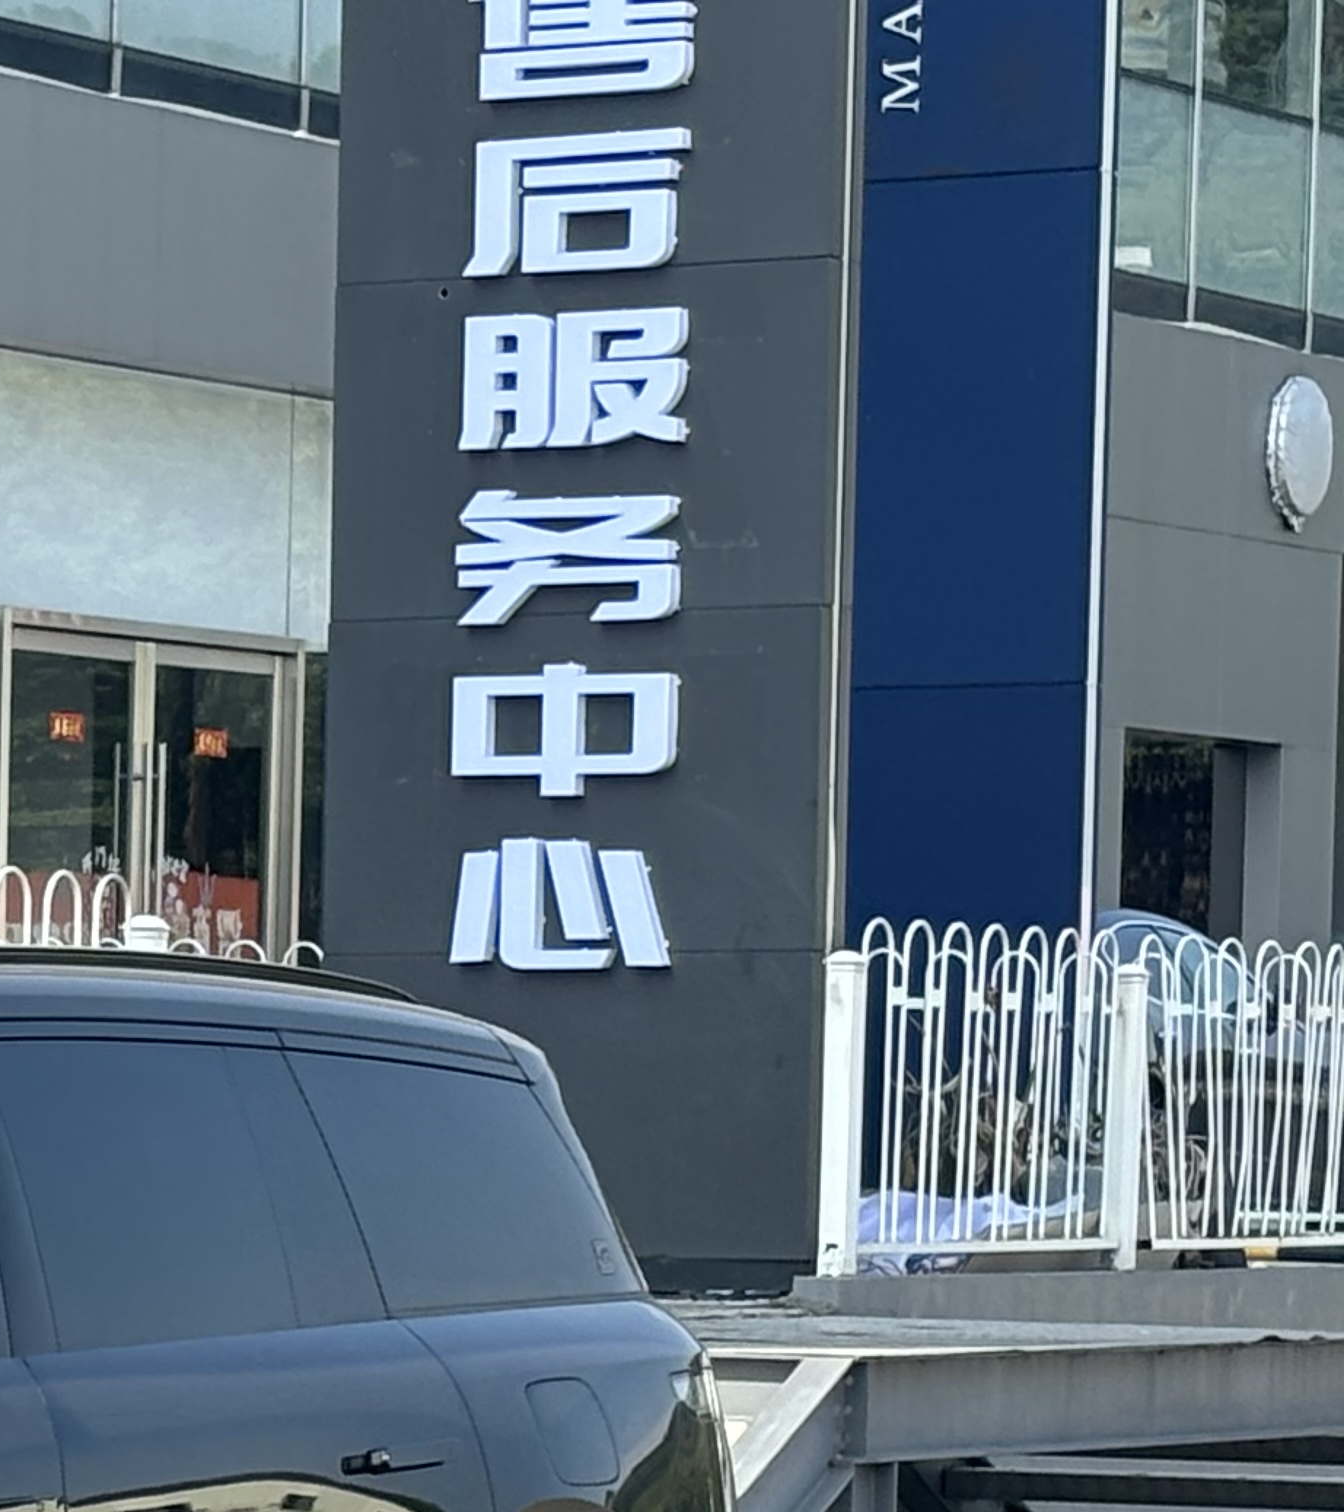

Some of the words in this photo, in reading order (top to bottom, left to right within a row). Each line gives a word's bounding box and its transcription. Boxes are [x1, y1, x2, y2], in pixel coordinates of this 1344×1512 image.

[449, 0, 697, 970] 售后服务中心
